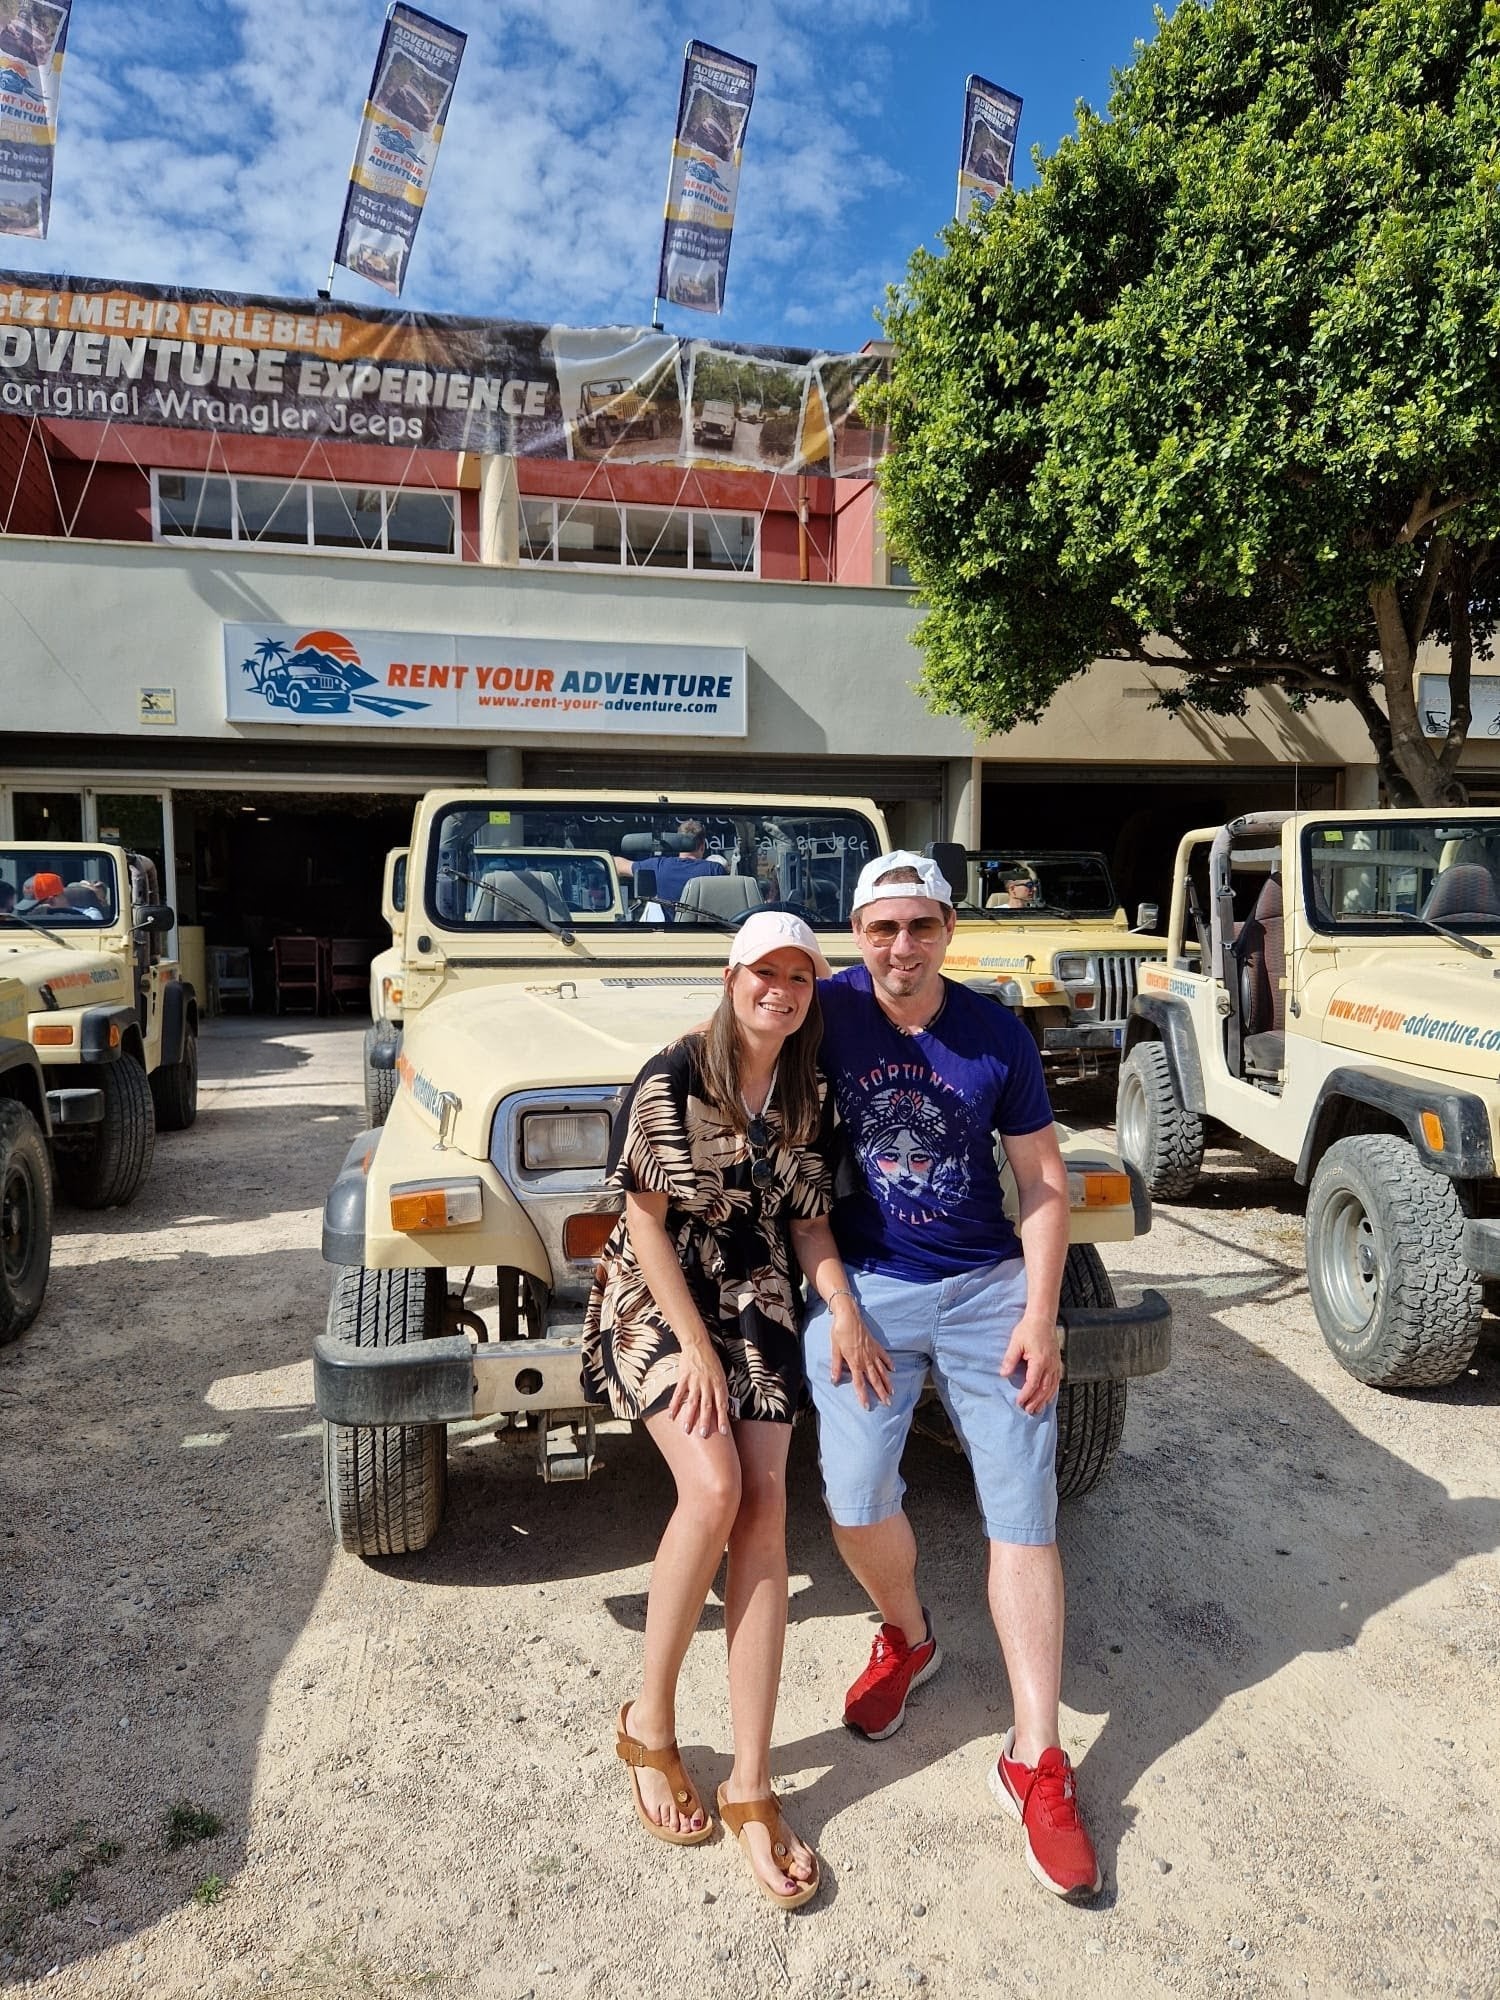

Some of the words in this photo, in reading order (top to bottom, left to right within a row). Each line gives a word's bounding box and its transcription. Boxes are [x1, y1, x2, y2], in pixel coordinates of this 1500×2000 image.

[393, 35, 444, 68] EXPERIENCE
[395, 27, 457, 65] ADVENTURE
[692, 73, 740, 95] EXPERIENCE
[693, 63, 750, 90] ADVENTURE
[974, 96, 1016, 127] ADVENTURE
[368, 155, 424, 188] ADVENTURE
[373, 146, 398, 162] RENT
[400, 158, 424, 176] YOUR
[356, 194, 386, 212] JETZT
[681, 189, 729, 213] ADVENTURE
[684, 180, 706, 193] RENT
[708, 187, 728, 204] YOUR
[69, 295, 179, 333] MEHR
[187, 306, 342, 349] ERLEBEN
[298, 360, 549, 416] EXPERIENCE
[2, 378, 139, 416] original
[155, 388, 316, 431] Wrangler
[329, 403, 423, 443] Jeeps
[387, 663, 469, 689] RENT
[475, 666, 555, 692] YOUR
[560, 670, 733, 698] ADVENTURE
[478, 695, 718, 713] www.rent-your-adventure.com
[1170, 979, 1196, 999] EXPERIENCE
[1328, 999, 1500, 1052] www.rent-your-adventure.co
